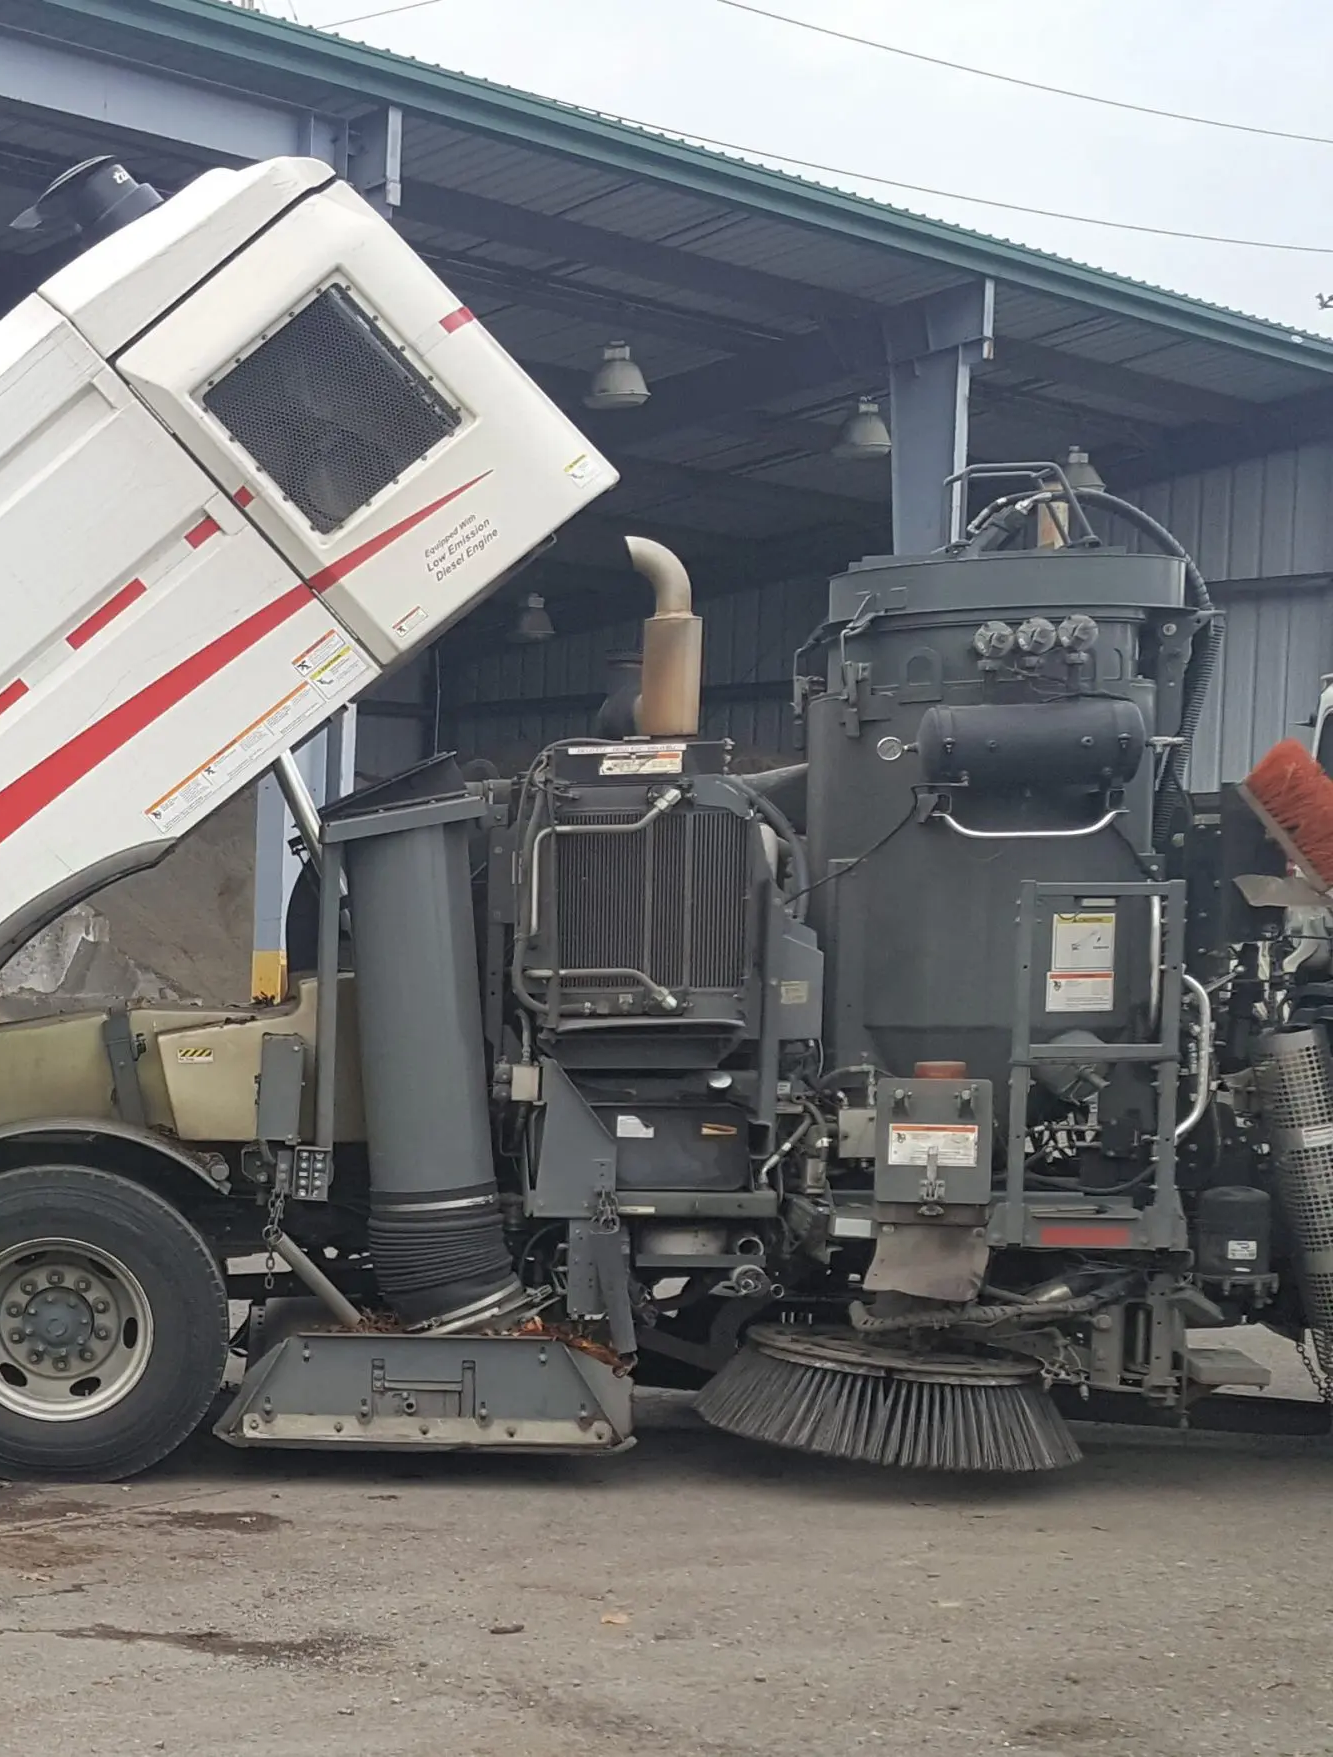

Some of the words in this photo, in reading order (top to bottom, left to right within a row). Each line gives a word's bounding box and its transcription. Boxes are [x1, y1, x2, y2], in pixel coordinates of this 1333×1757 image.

[425, 526, 459, 558] Equipped
[427, 553, 447, 572] Low
[448, 518, 490, 555] Emission
[436, 553, 465, 581] Diesel
[466, 529, 498, 558] Engine
